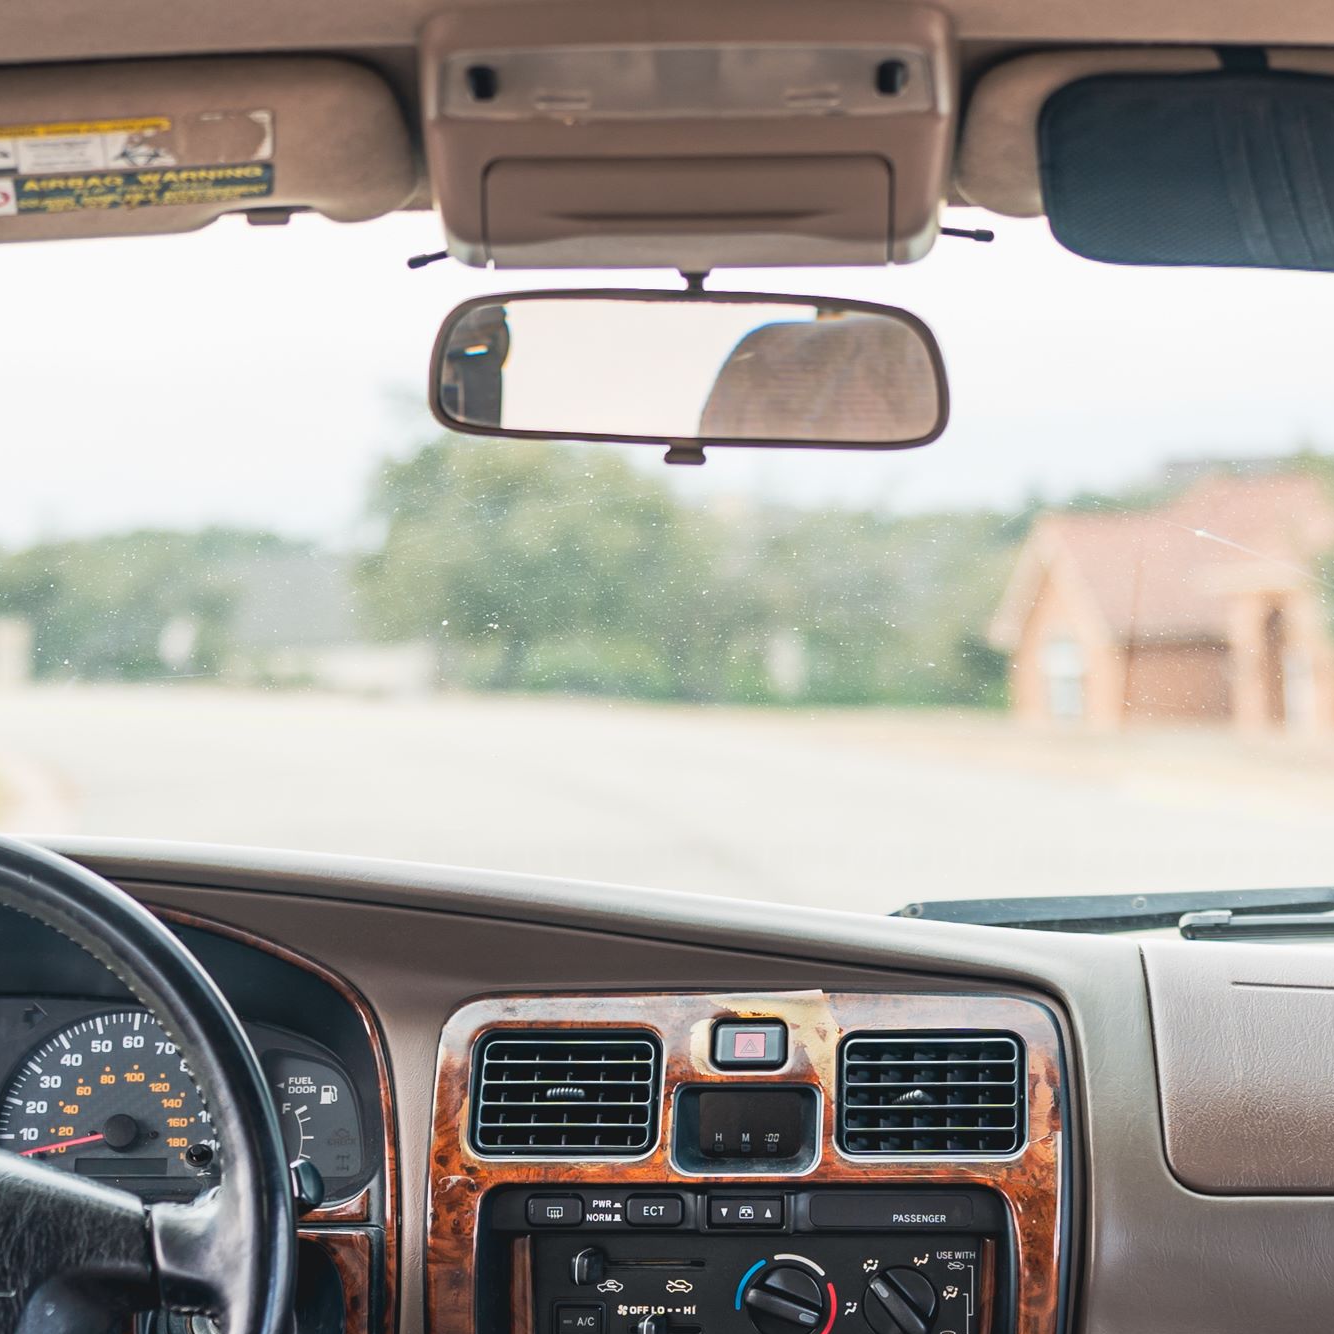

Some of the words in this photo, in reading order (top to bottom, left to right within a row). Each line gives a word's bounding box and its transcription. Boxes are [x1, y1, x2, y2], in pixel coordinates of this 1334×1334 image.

[23, 175, 124, 192] AIRBAG
[137, 166, 263, 184] WARNING
[91, 1040, 112, 1052] 50
[122, 1036, 144, 1048] 60
[154, 1042, 175, 1054] 70
[60, 1054, 82, 1066] 40
[39, 1075, 62, 1088] 30
[100, 1074, 115, 1084] 80
[124, 1072, 145, 1082] 100
[288, 1077, 314, 1085] FUEL
[76, 1086, 92, 1096] 60
[149, 1082, 170, 1092] 120
[288, 1086, 317, 1094] DOOR
[25, 1101, 48, 1114] 20
[161, 1099, 182, 1108] 140
[282, 1103, 291, 1114] F
[63, 1105, 79, 1114] 40
[167, 1118, 188, 1127] 160
[19, 1128, 39, 1140] 10
[58, 1126, 74, 1136] 20
[167, 1138, 188, 1147] 180
[715, 1133, 723, 1142] H
[741, 1133, 750, 1142] M
[592, 1200, 612, 1208] PWR
[643, 1206, 665, 1216] ECT
[586, 1213, 612, 1222] NORM
[892, 1214, 947, 1223] PASSENGER
[936, 1251, 953, 1260] USE
[954, 1251, 976, 1260] WITH
[629, 1306, 649, 1315] OFF
[651, 1306, 666, 1315] LO
[683, 1305, 697, 1315] HI
[576, 1316, 595, 1327] A/C
